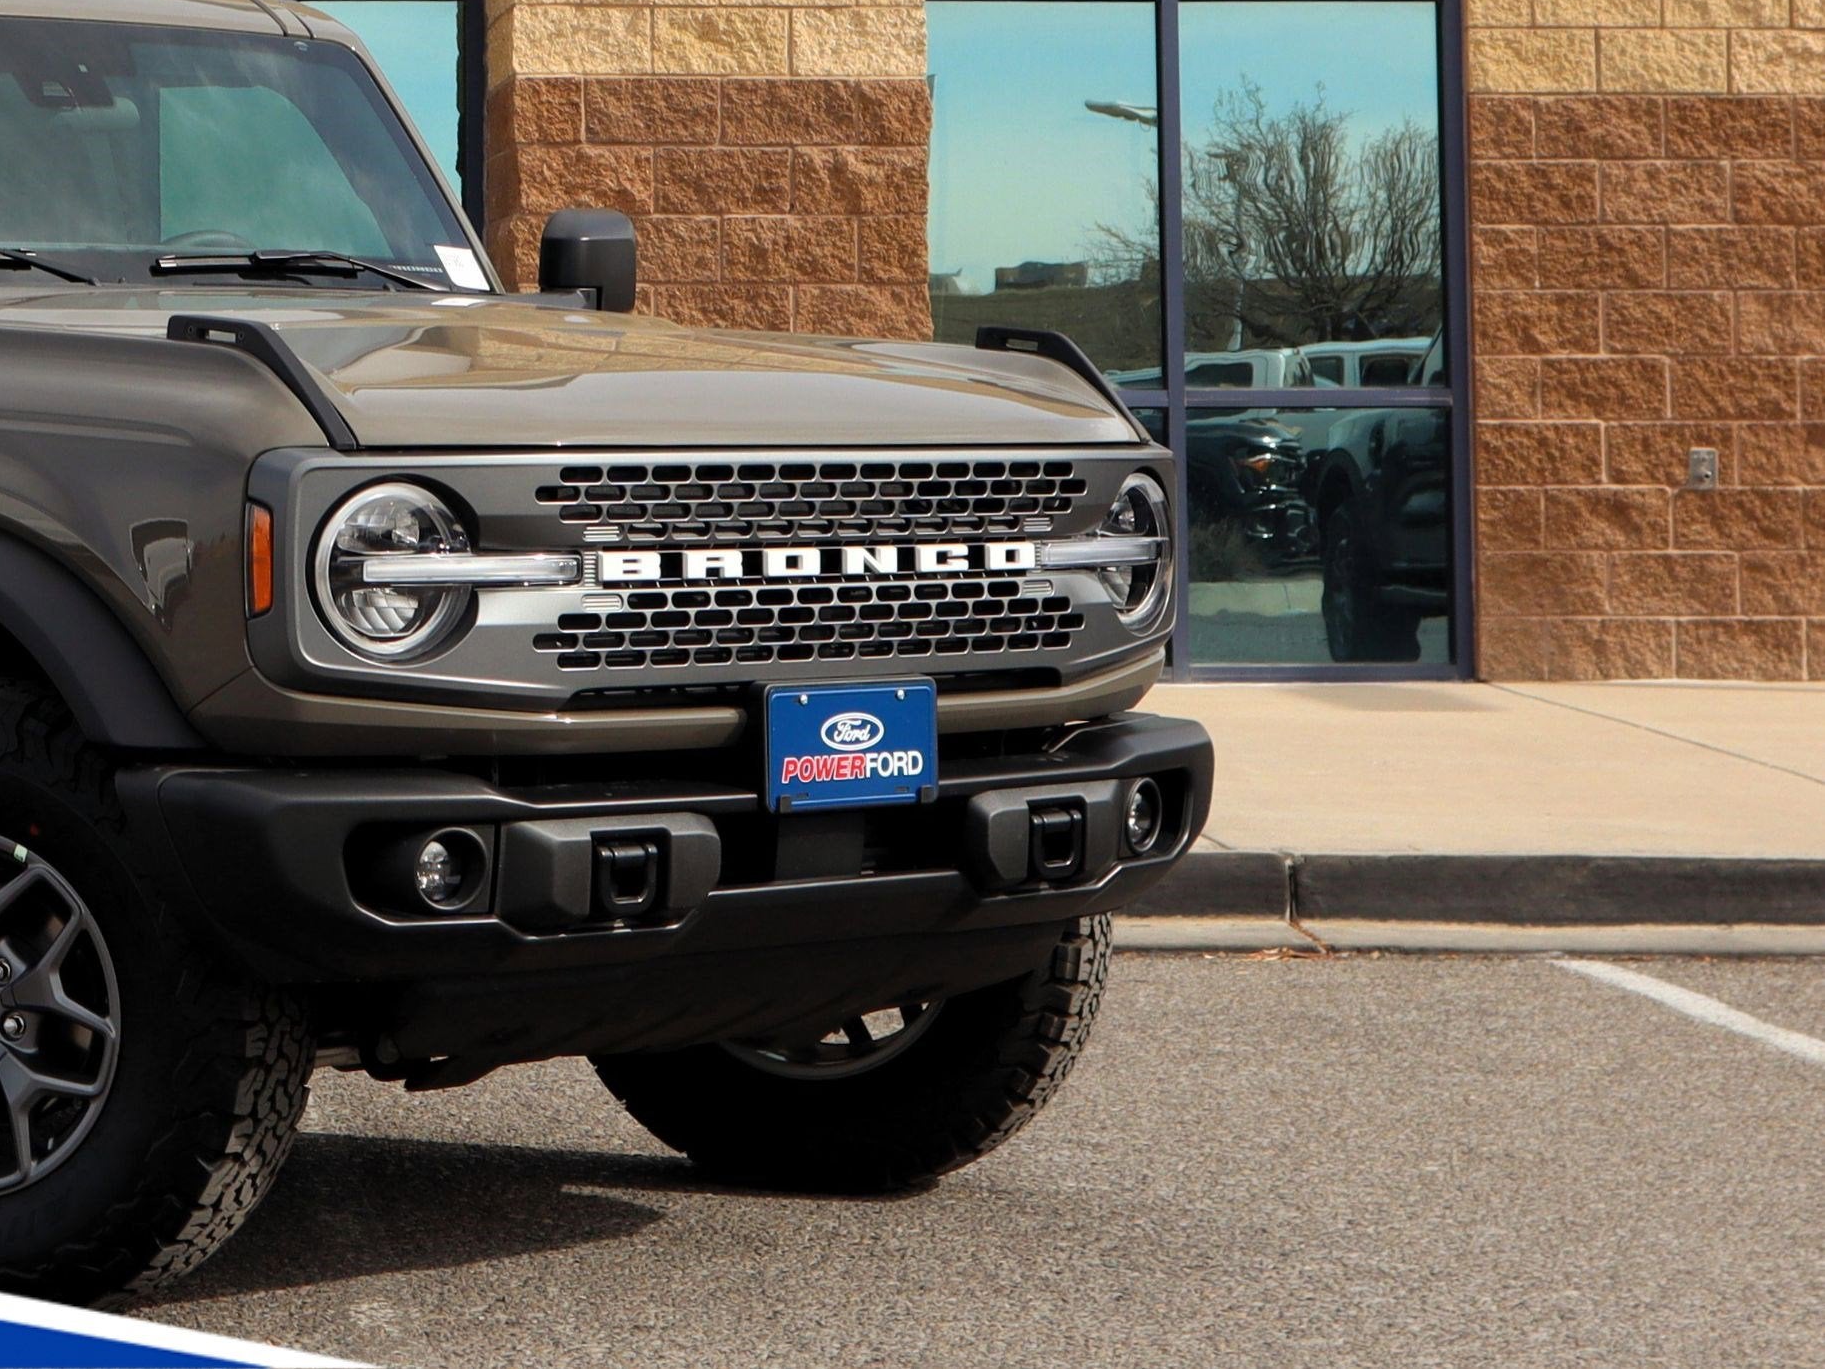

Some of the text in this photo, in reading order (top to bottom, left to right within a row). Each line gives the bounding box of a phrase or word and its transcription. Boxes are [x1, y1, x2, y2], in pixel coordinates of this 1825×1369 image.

[597, 541, 1036, 582] BRONCO
[833, 719, 871, 743] Ford
[781, 750, 923, 784] POWERFORD
